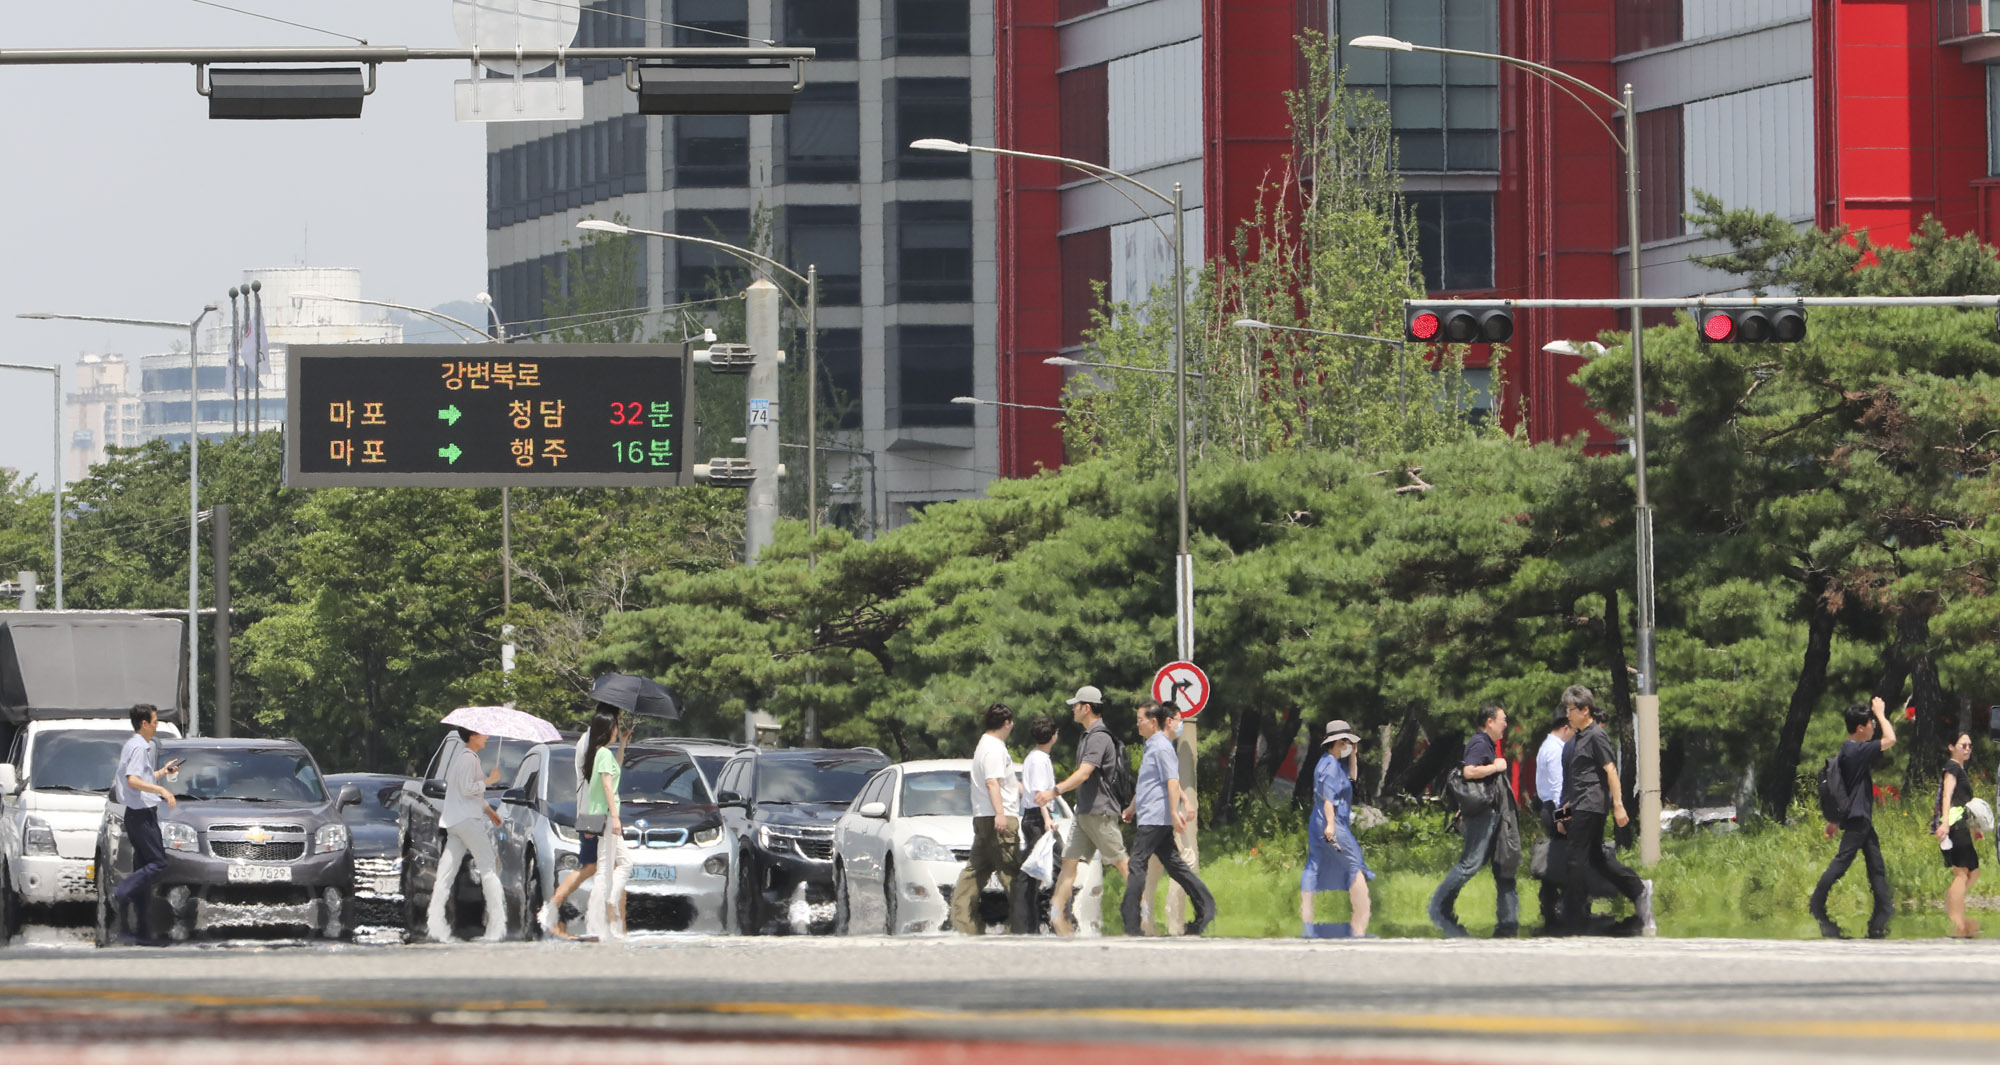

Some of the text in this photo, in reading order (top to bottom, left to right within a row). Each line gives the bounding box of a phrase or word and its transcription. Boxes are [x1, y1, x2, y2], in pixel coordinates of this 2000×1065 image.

[442, 361, 540, 390] 강변북로
[330, 400, 673, 429] 마포 청담 32분
[751, 409, 767, 423] 74
[330, 438, 673, 467] 마포 행주 16분
